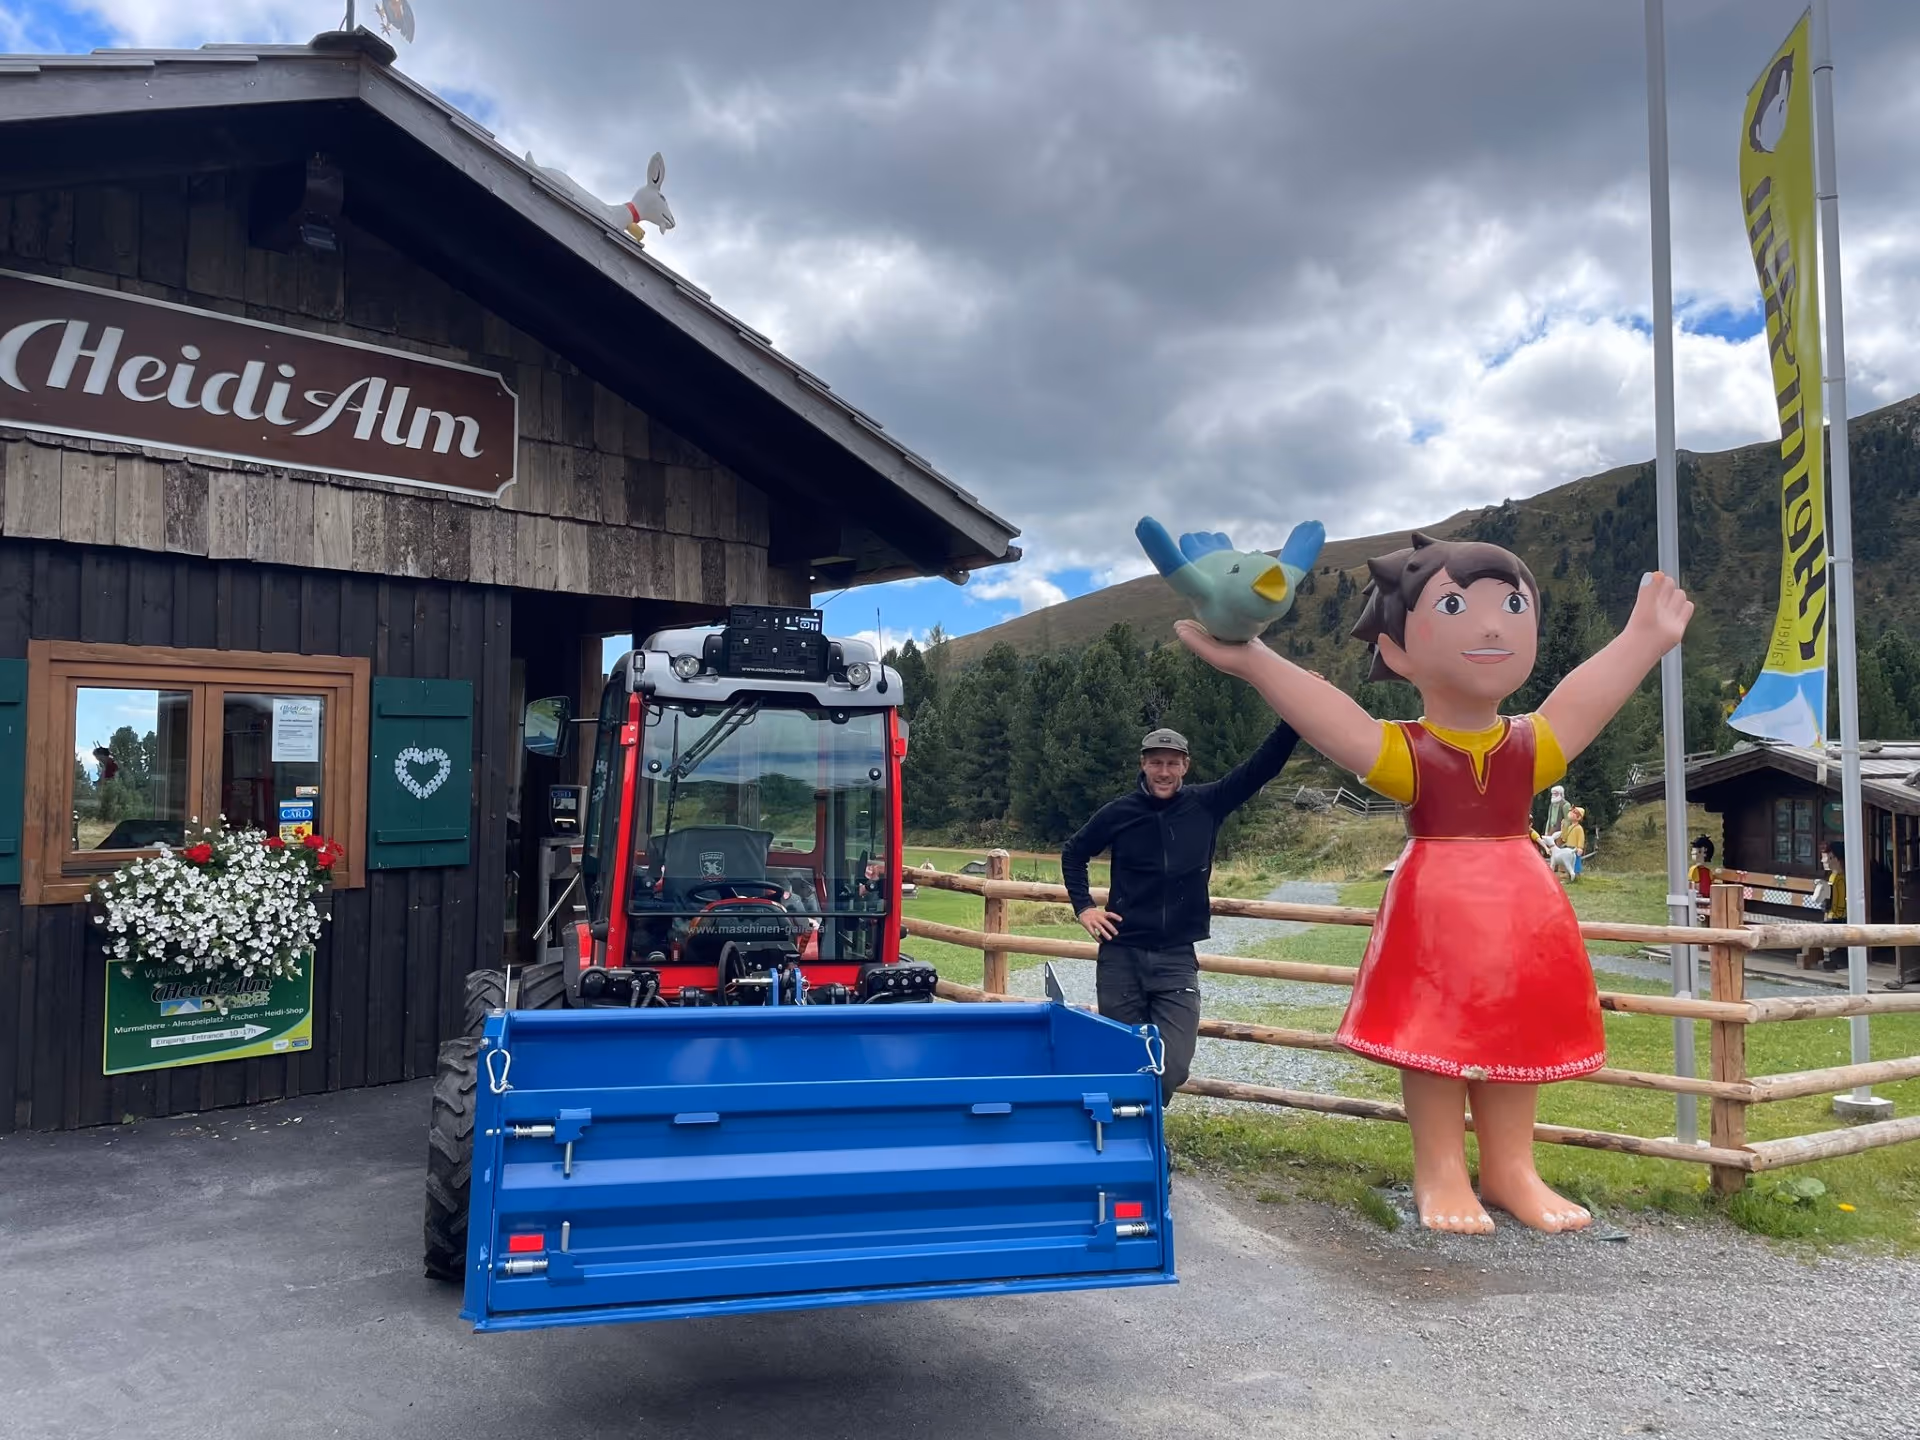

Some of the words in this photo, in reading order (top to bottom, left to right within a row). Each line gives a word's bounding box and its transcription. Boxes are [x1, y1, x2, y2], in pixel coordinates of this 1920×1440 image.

[0, 319, 299, 426] Heidi
[292, 376, 485, 459] Alm
[281, 808, 312, 819] CARD
[114, 1023, 166, 1034] Murmeltiere
[172, 1015, 224, 1028] Almspielplatz
[230, 1012, 259, 1021] Fischen
[264, 1007, 304, 1018] Heidi-Shop
[191, 1031, 225, 1041] Entrance
[229, 1029, 239, 1037] 10
